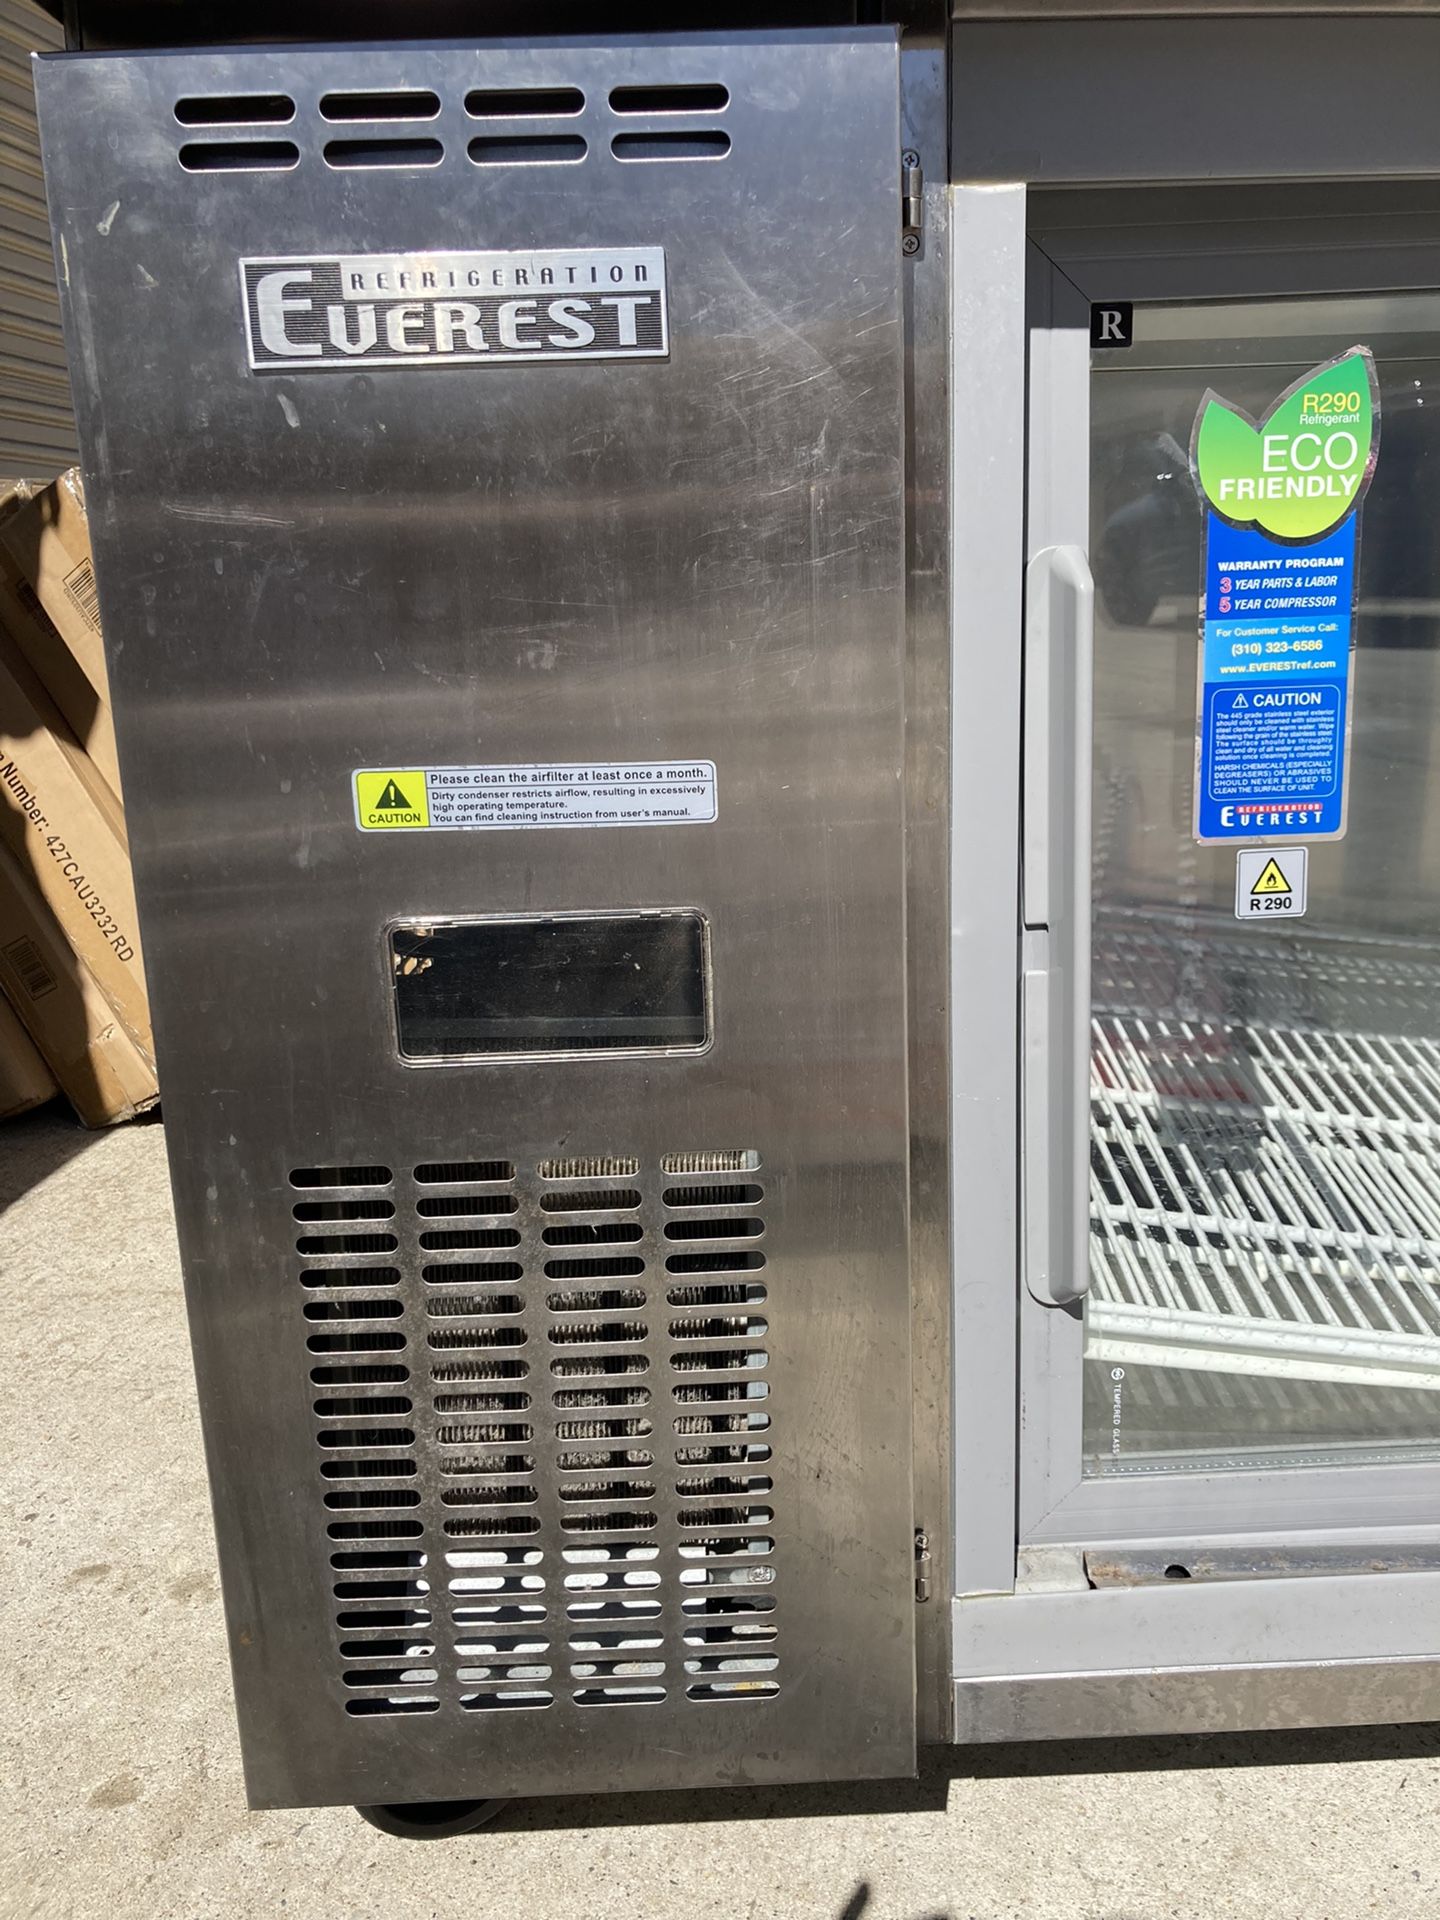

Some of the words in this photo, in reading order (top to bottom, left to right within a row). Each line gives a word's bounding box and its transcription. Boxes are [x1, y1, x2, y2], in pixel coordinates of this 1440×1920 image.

[351, 264, 649, 291] REFRIGERATION
[1099, 310, 1126, 340] R
[1303, 391, 1361, 413] R290
[1299, 413, 1361, 427] Refrigerant
[1262, 431, 1358, 473] ECO
[1218, 474, 1358, 501] FRIENDLY
[1217, 560, 1283, 571] WARRANTY
[1285, 556, 1344, 568] PROGRAM
[1219, 576, 1232, 594] 3
[1235, 579, 1260, 590] YEAR
[1261, 577, 1293, 589] PARTS
[1294, 576, 1303, 588] &
[1304, 575, 1338, 588] LABOR
[1218, 596, 1231, 613] 5
[1234, 599, 1261, 610] YEAR
[1264, 596, 1337, 609] COMPRESSOR
[1216, 629, 1232, 637] For
[1233, 627, 1279, 637] Customer
[1281, 625, 1316, 634] Service
[1317, 622, 1339, 632] Call:
[1231, 642, 1262, 657] (310)
[1265, 639, 1323, 653] 323-6586
[1220, 660, 1336, 674] www.EVERESTref.com
[1253, 692, 1321, 707] CAUTION
[1216, 712, 1229, 720] The
[1216, 740, 1229, 748] The
[1214, 764, 1241, 772] HARSH
[1241, 762, 1285, 770] CHEMICALS
[1214, 770, 1272, 780] DEGREASERS)
[1286, 768, 1332, 776] ABRASIVES
[430, 773, 470, 785] Please
[473, 772, 506, 783] clean
[509, 771, 529, 783] the
[531, 769, 575, 782] airfilter
[577, 771, 589, 780] at
[592, 769, 621, 780] least
[624, 770, 653, 780] once
[656, 770, 663, 779] a
[666, 767, 708, 779] month.
[1214, 779, 1248, 788] SHOULD
[1250, 778, 1280, 786] NEVER
[1281, 776, 1294, 784] BE
[1295, 775, 1319, 783] USED
[1321, 774, 1333, 782] TO
[0, 761, 49, 832] Number:
[432, 792, 456, 801] Dirty
[457, 790, 510, 800] condenser
[511, 788, 553, 798] restricts
[555, 788, 591, 798] airflow,
[592, 786, 636, 798] resulting
[638, 787, 648, 796] in
[649, 784, 706, 796] excessively
[1213, 787, 1238, 796] CLEAN
[1238, 785, 1252, 793] THE
[1253, 784, 1286, 792] SURFACE
[1286, 784, 1298, 792] OF
[432, 802, 455, 813] high
[456, 801, 504, 812] operating
[506, 800, 568, 811] temperature.
[368, 813, 421, 824] CAUTION
[433, 814, 452, 823] You
[454, 813, 473, 822] can
[475, 812, 495, 821] find
[496, 810, 538, 821] cleaning
[540, 809, 593, 820] instruction
[595, 810, 618, 818] from
[620, 808, 650, 817] user's
[652, 808, 691, 817] manual.
[1250, 898, 1261, 911] R
[1264, 896, 1292, 910] 290
[1113, 1383, 1121, 1426] TEMPERED
[1112, 1427, 1120, 1455] GLASS
